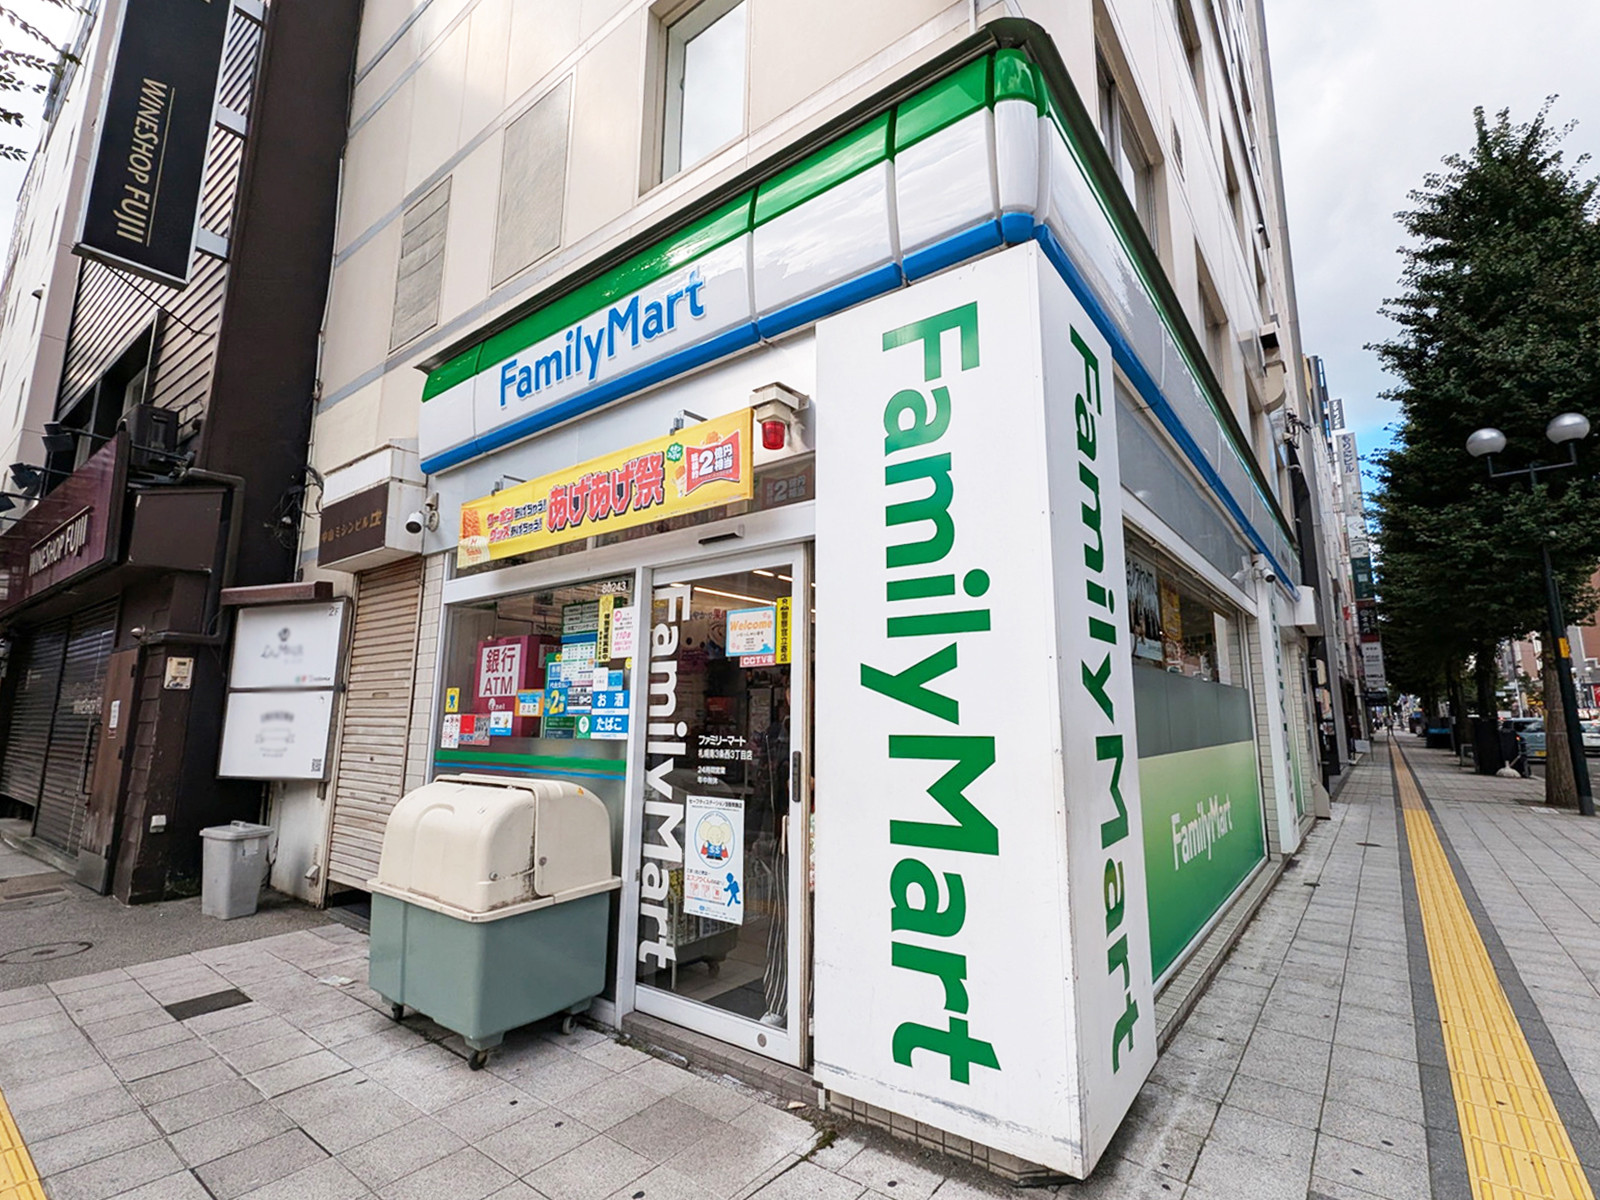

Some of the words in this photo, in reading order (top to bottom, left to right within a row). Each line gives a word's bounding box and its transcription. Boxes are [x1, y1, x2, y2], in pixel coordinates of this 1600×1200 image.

[127, 77, 168, 185] WINESHOP
[113, 184, 150, 243] FUJII
[499, 270, 705, 407] FamilyMart
[547, 452, 665, 533] あげあげ祭
[698, 450, 714, 476] 2
[28, 534, 65, 577] WINESHOP
[64, 514, 88, 556] FUJII
[328, 606, 340, 617] 2F
[730, 619, 772, 631] Welcome
[483, 676, 513, 696] ATM
[486, 647, 516, 673] 銀行
[860, 300, 1002, 1086] FamilyMart
[1068, 323, 1139, 1075] FamilyMart
[596, 717, 622, 731] たばこ
[698, 735, 747, 747] ファミリーマート
[640, 583, 692, 970] FamilyMart
[1170, 794, 1233, 872] FamilyMart
